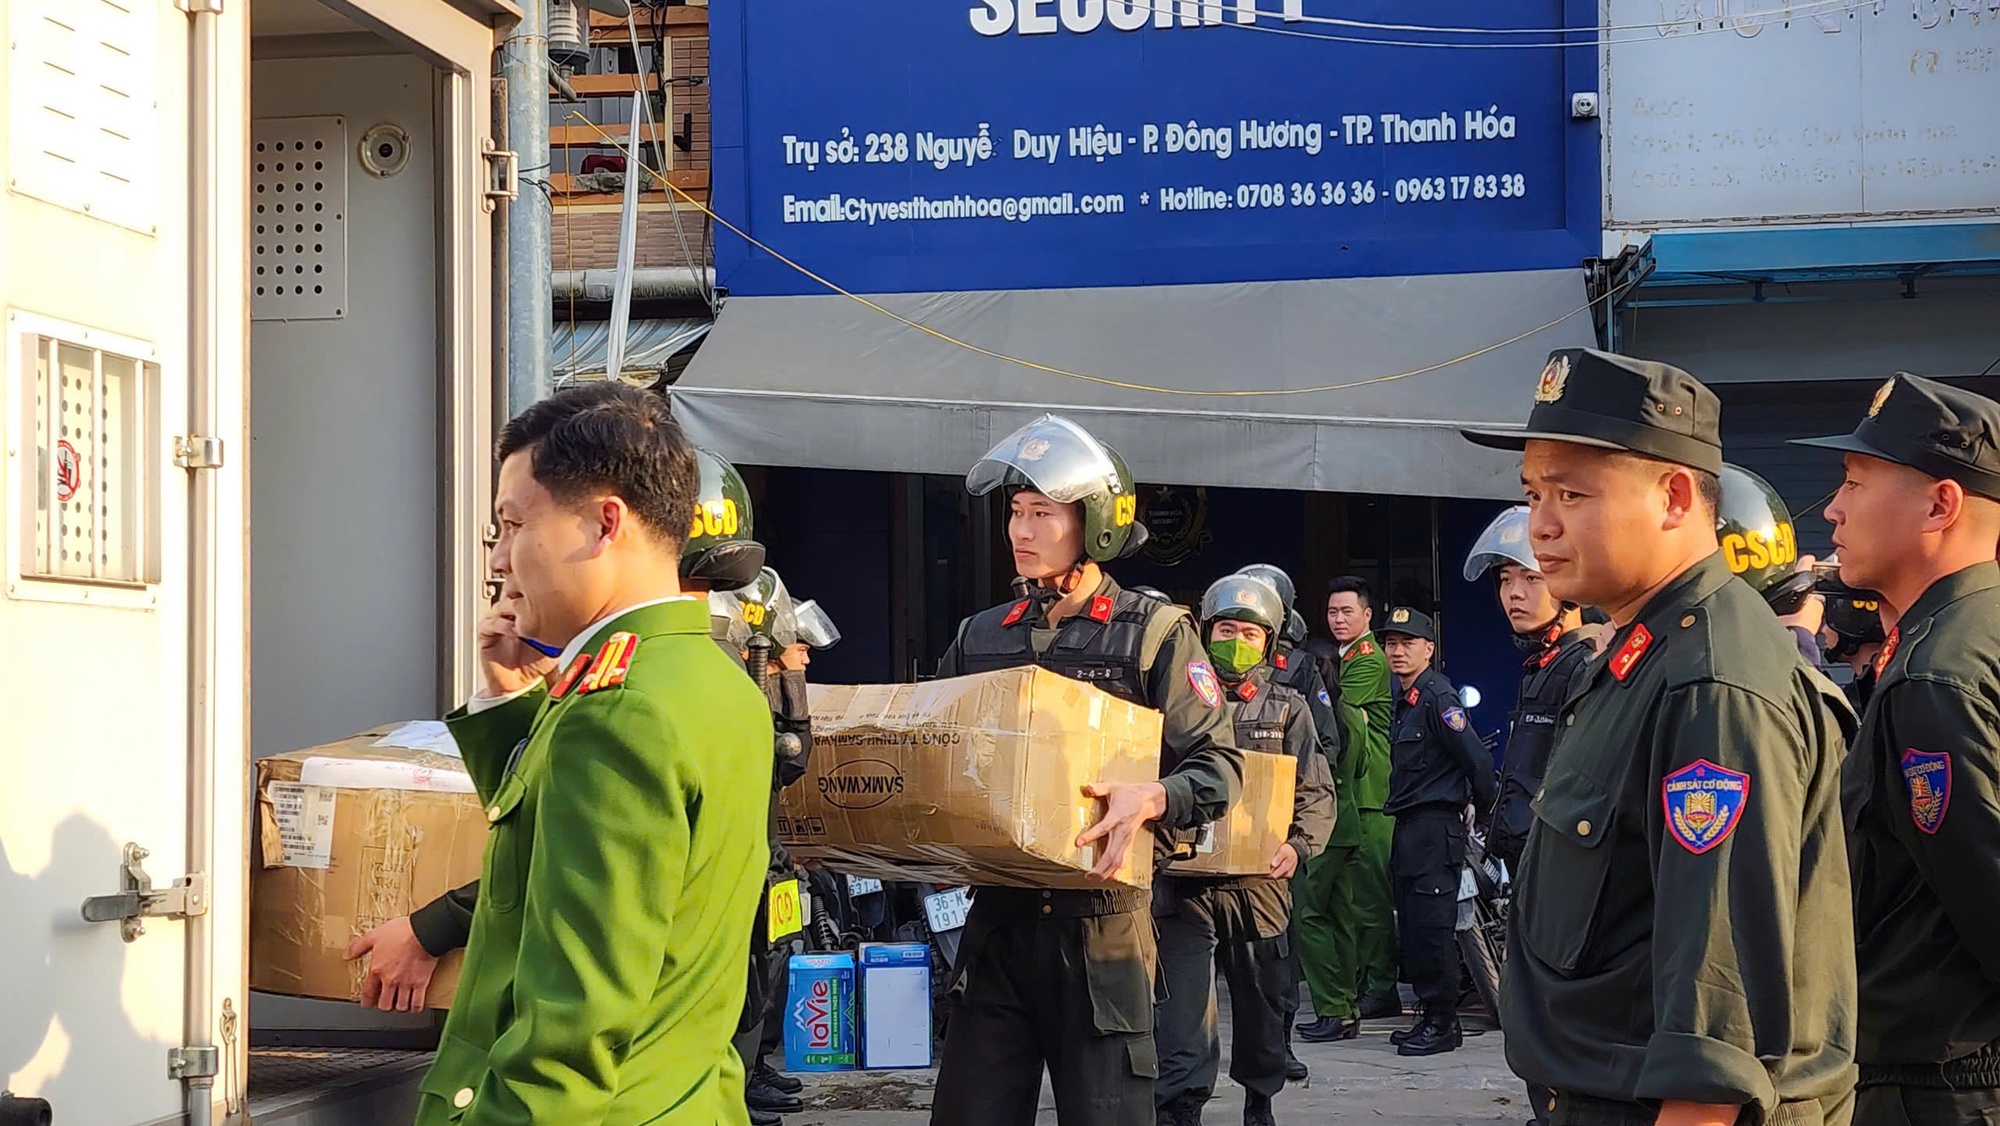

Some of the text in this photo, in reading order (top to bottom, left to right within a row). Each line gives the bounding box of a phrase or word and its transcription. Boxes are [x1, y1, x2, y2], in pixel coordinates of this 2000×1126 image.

[969, 0, 1303, 36] SECU
[782, 135, 819, 171] Trụ
[825, 126, 859, 164] sở:
[865, 132, 909, 163] 238
[1013, 129, 1061, 164] Duy
[1069, 123, 1122, 162] Hiệu
[1143, 124, 1159, 154] P.
[1165, 120, 1232, 159] Đông
[1240, 119, 1322, 155] Hương
[1380, 111, 1456, 144] Thanh
[1465, 104, 1516, 140] Hóa
[1160, 186, 1233, 211] Hotline:
[1237, 183, 1285, 208] 0708
[1290, 182, 1316, 206] 36
[1321, 181, 1346, 205] 36
[1350, 180, 1376, 205] 36
[1395, 177, 1446, 203] 0963
[921, 733, 961, 748] CÔNG
[818, 775, 905, 794] SAMKWANG
